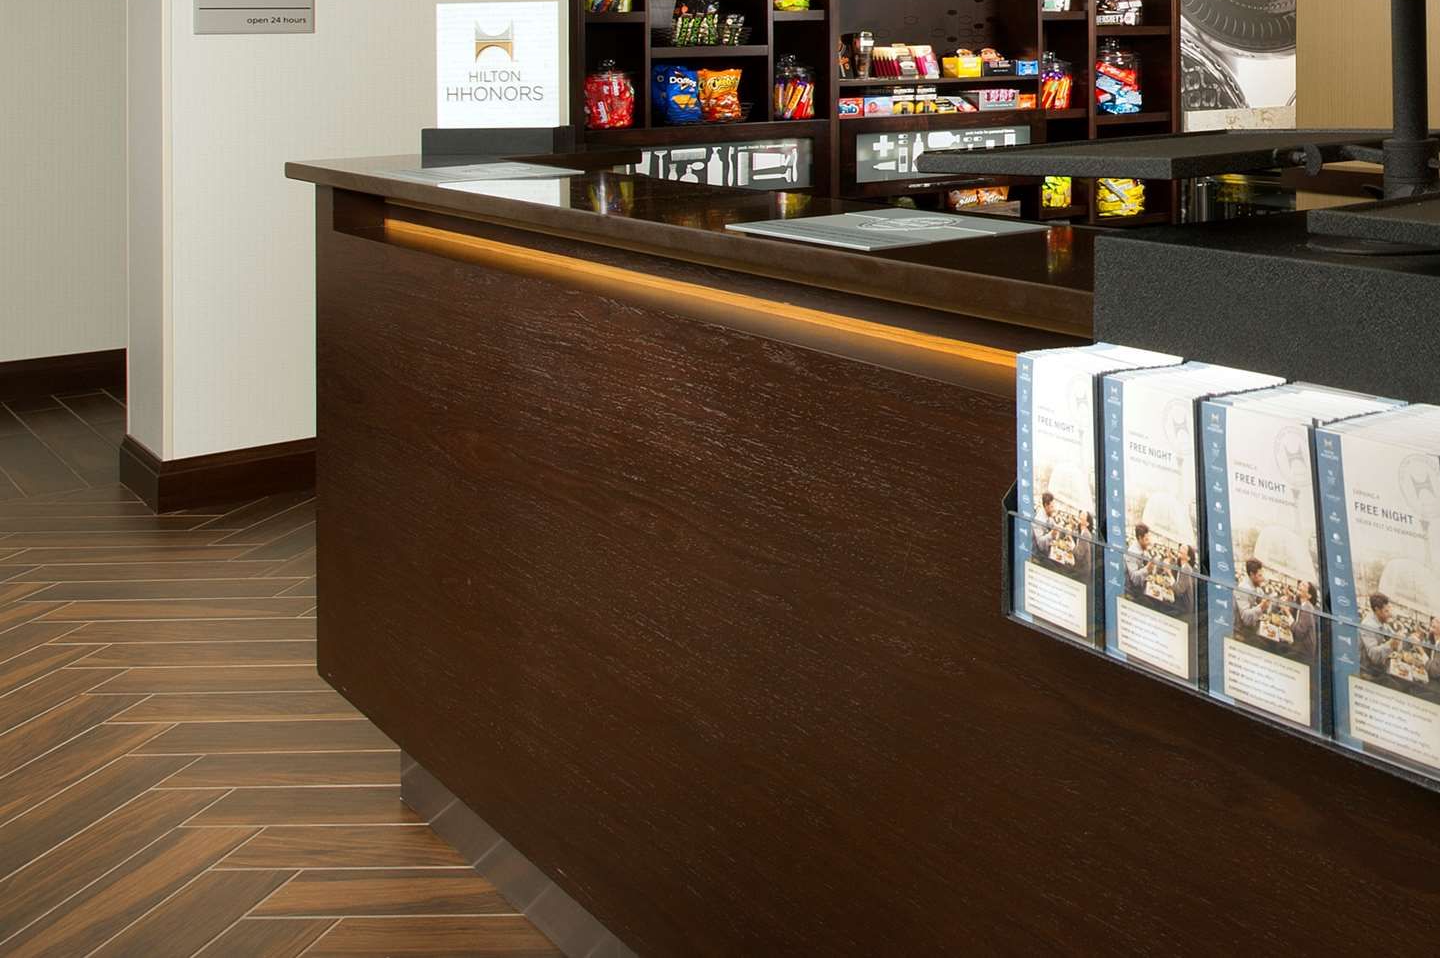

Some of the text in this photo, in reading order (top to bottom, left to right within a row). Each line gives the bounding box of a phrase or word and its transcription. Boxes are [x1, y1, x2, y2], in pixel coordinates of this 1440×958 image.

[469, 70, 521, 83] HILTON
[446, 85, 544, 102] HHONORS
[1037, 415, 1075, 434] FREE NIGHT
[1129, 441, 1172, 462] FREE NIGHT
[1235, 472, 1286, 495] FREE NIGHT
[1354, 501, 1414, 525] FREE NIGHT
